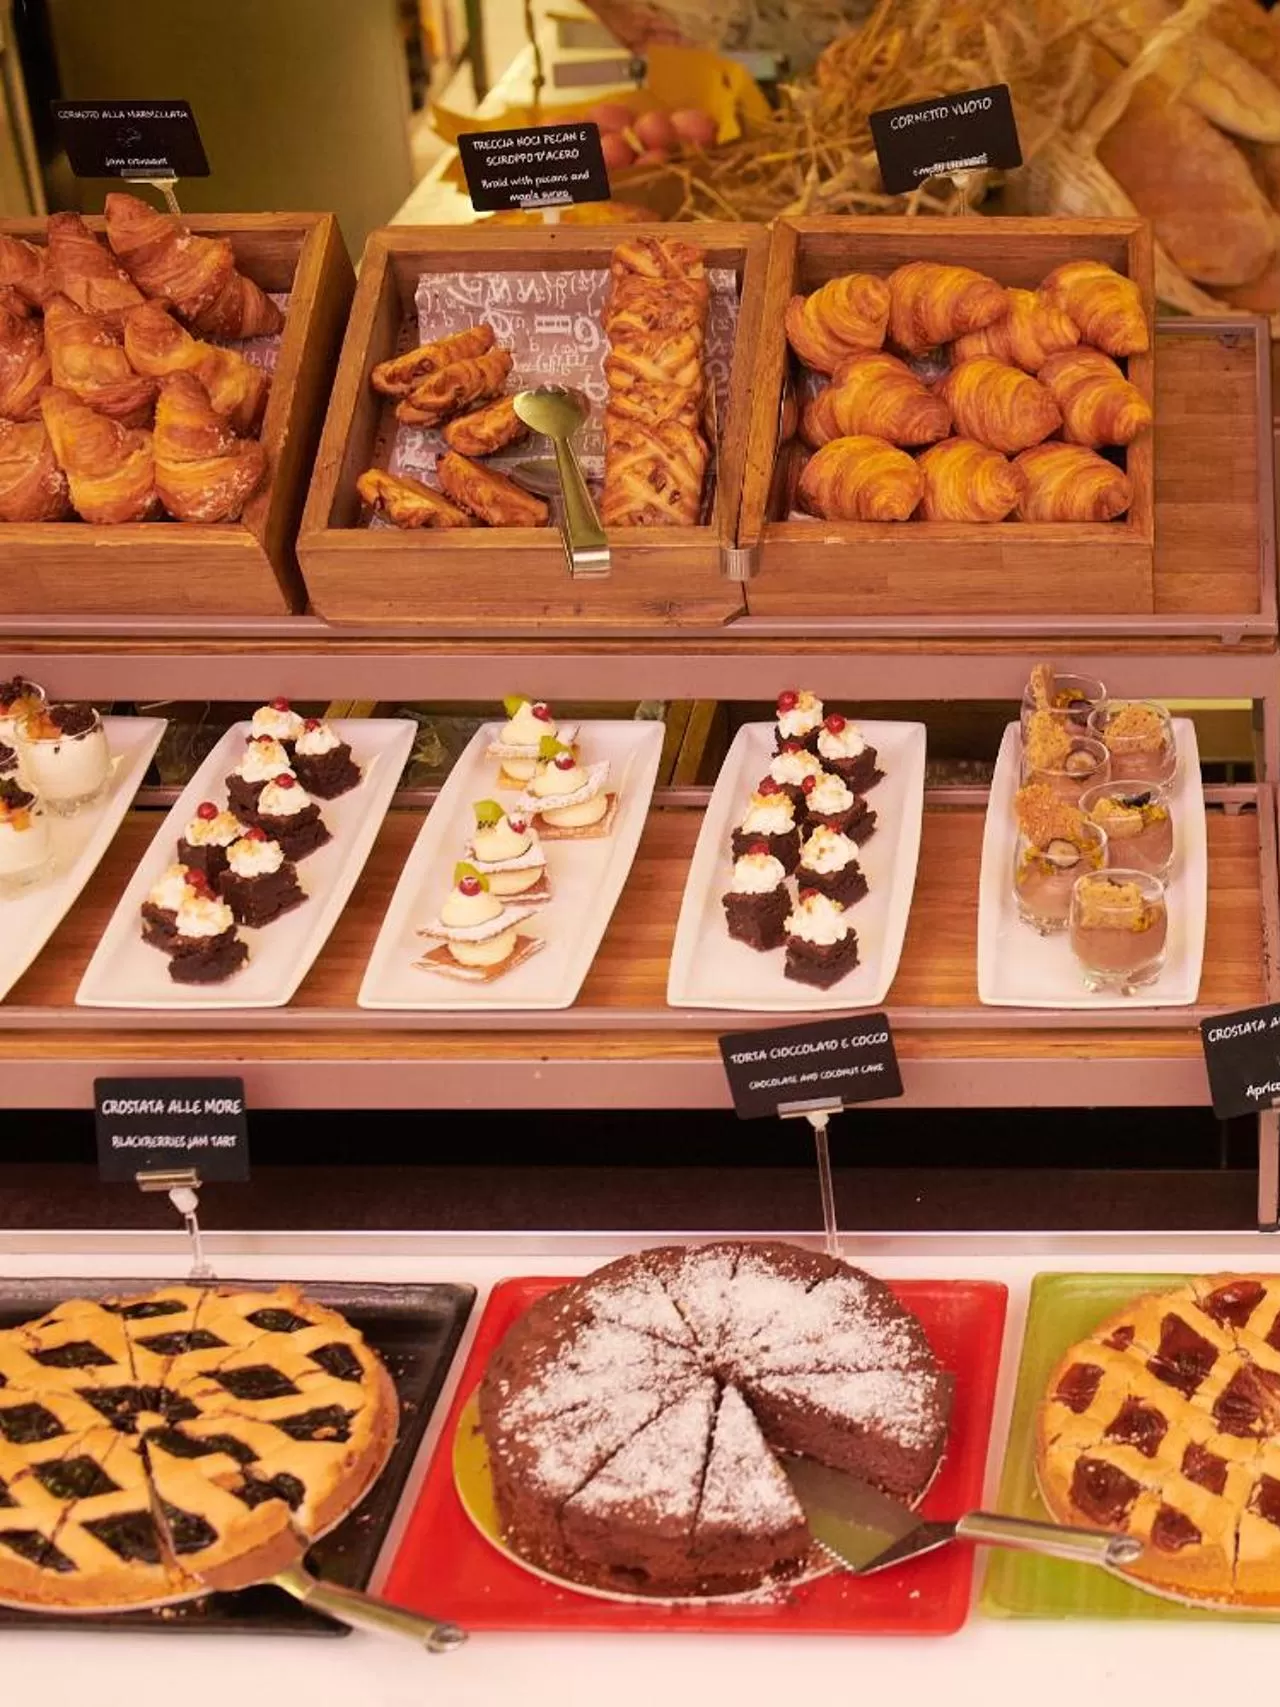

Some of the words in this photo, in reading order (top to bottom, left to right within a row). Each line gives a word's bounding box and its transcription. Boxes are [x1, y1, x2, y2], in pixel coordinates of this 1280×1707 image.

[890, 107, 949, 131] CORNETTO
[951, 97, 992, 116] VUOTO
[473, 138, 514, 150] TRECCIA
[517, 136, 540, 147] NOCI
[544, 132, 576, 145] PECAN
[580, 131, 587, 141] E
[486, 153, 533, 167] SCIROPPO
[481, 176, 509, 189] Braid
[510, 176, 533, 186] with
[535, 173, 568, 188] pecans
[571, 169, 590, 180] and
[1208, 1019, 1266, 1042] CROSTATA
[730, 1051, 767, 1064] TORTA
[770, 1038, 838, 1059] CIOCCOLATO
[841, 1038, 849, 1049] E
[852, 1032, 889, 1048] COCCO
[749, 1075, 798, 1090] CHOCOLATE
[800, 1073, 818, 1083] AND
[820, 1066, 859, 1080] COCONUT
[862, 1063, 884, 1074] CAKE
[101, 1099, 164, 1114] CROSTATA
[167, 1099, 202, 1114] ALLE
[204, 1098, 242, 1114] MORE
[111, 1135, 186, 1149] BLACKBERRIES
[210, 1135, 237, 1148] TART
